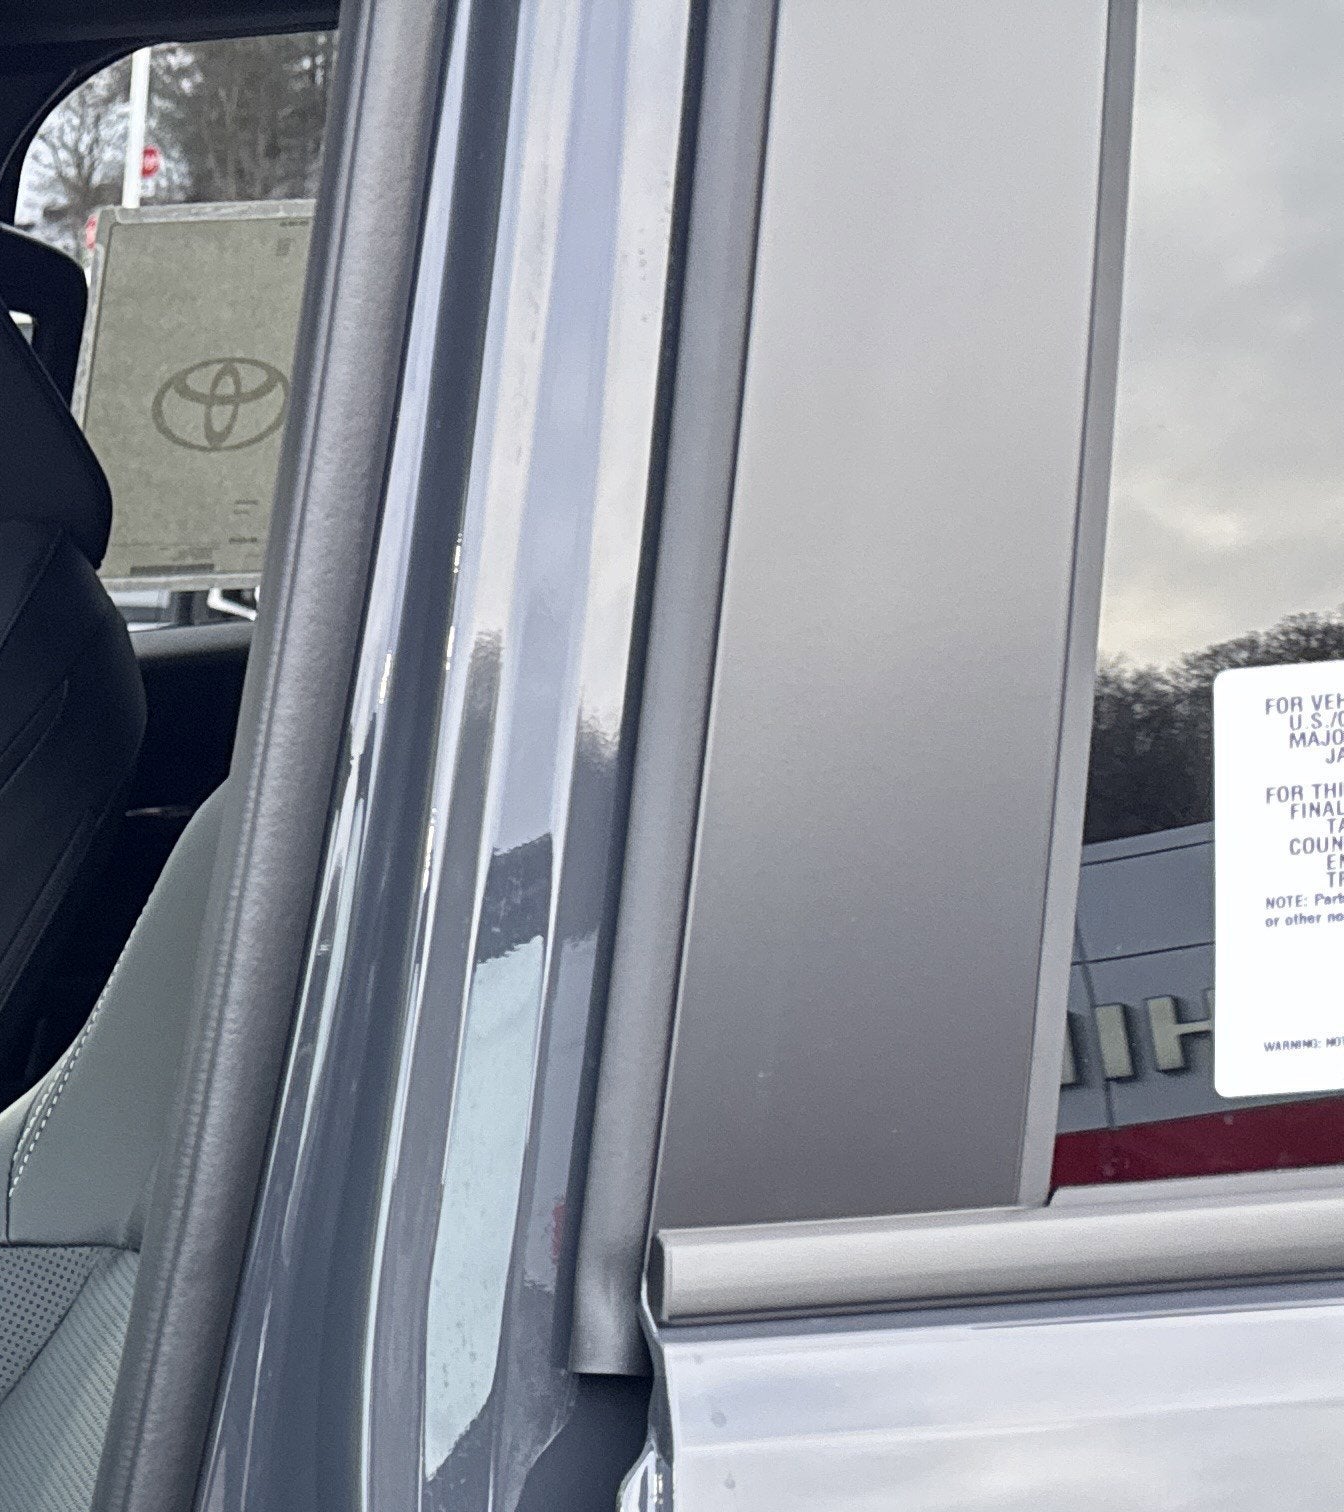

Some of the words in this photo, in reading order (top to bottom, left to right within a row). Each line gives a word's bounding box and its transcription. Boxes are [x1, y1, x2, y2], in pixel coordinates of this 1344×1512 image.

[1265, 696, 1303, 715] FOR
[1266, 785, 1304, 804] FOR
[1291, 800, 1344, 820] FINAL
[1265, 894, 1308, 909] NOTE:
[1265, 917, 1280, 928] or
[1285, 912, 1322, 926] other
